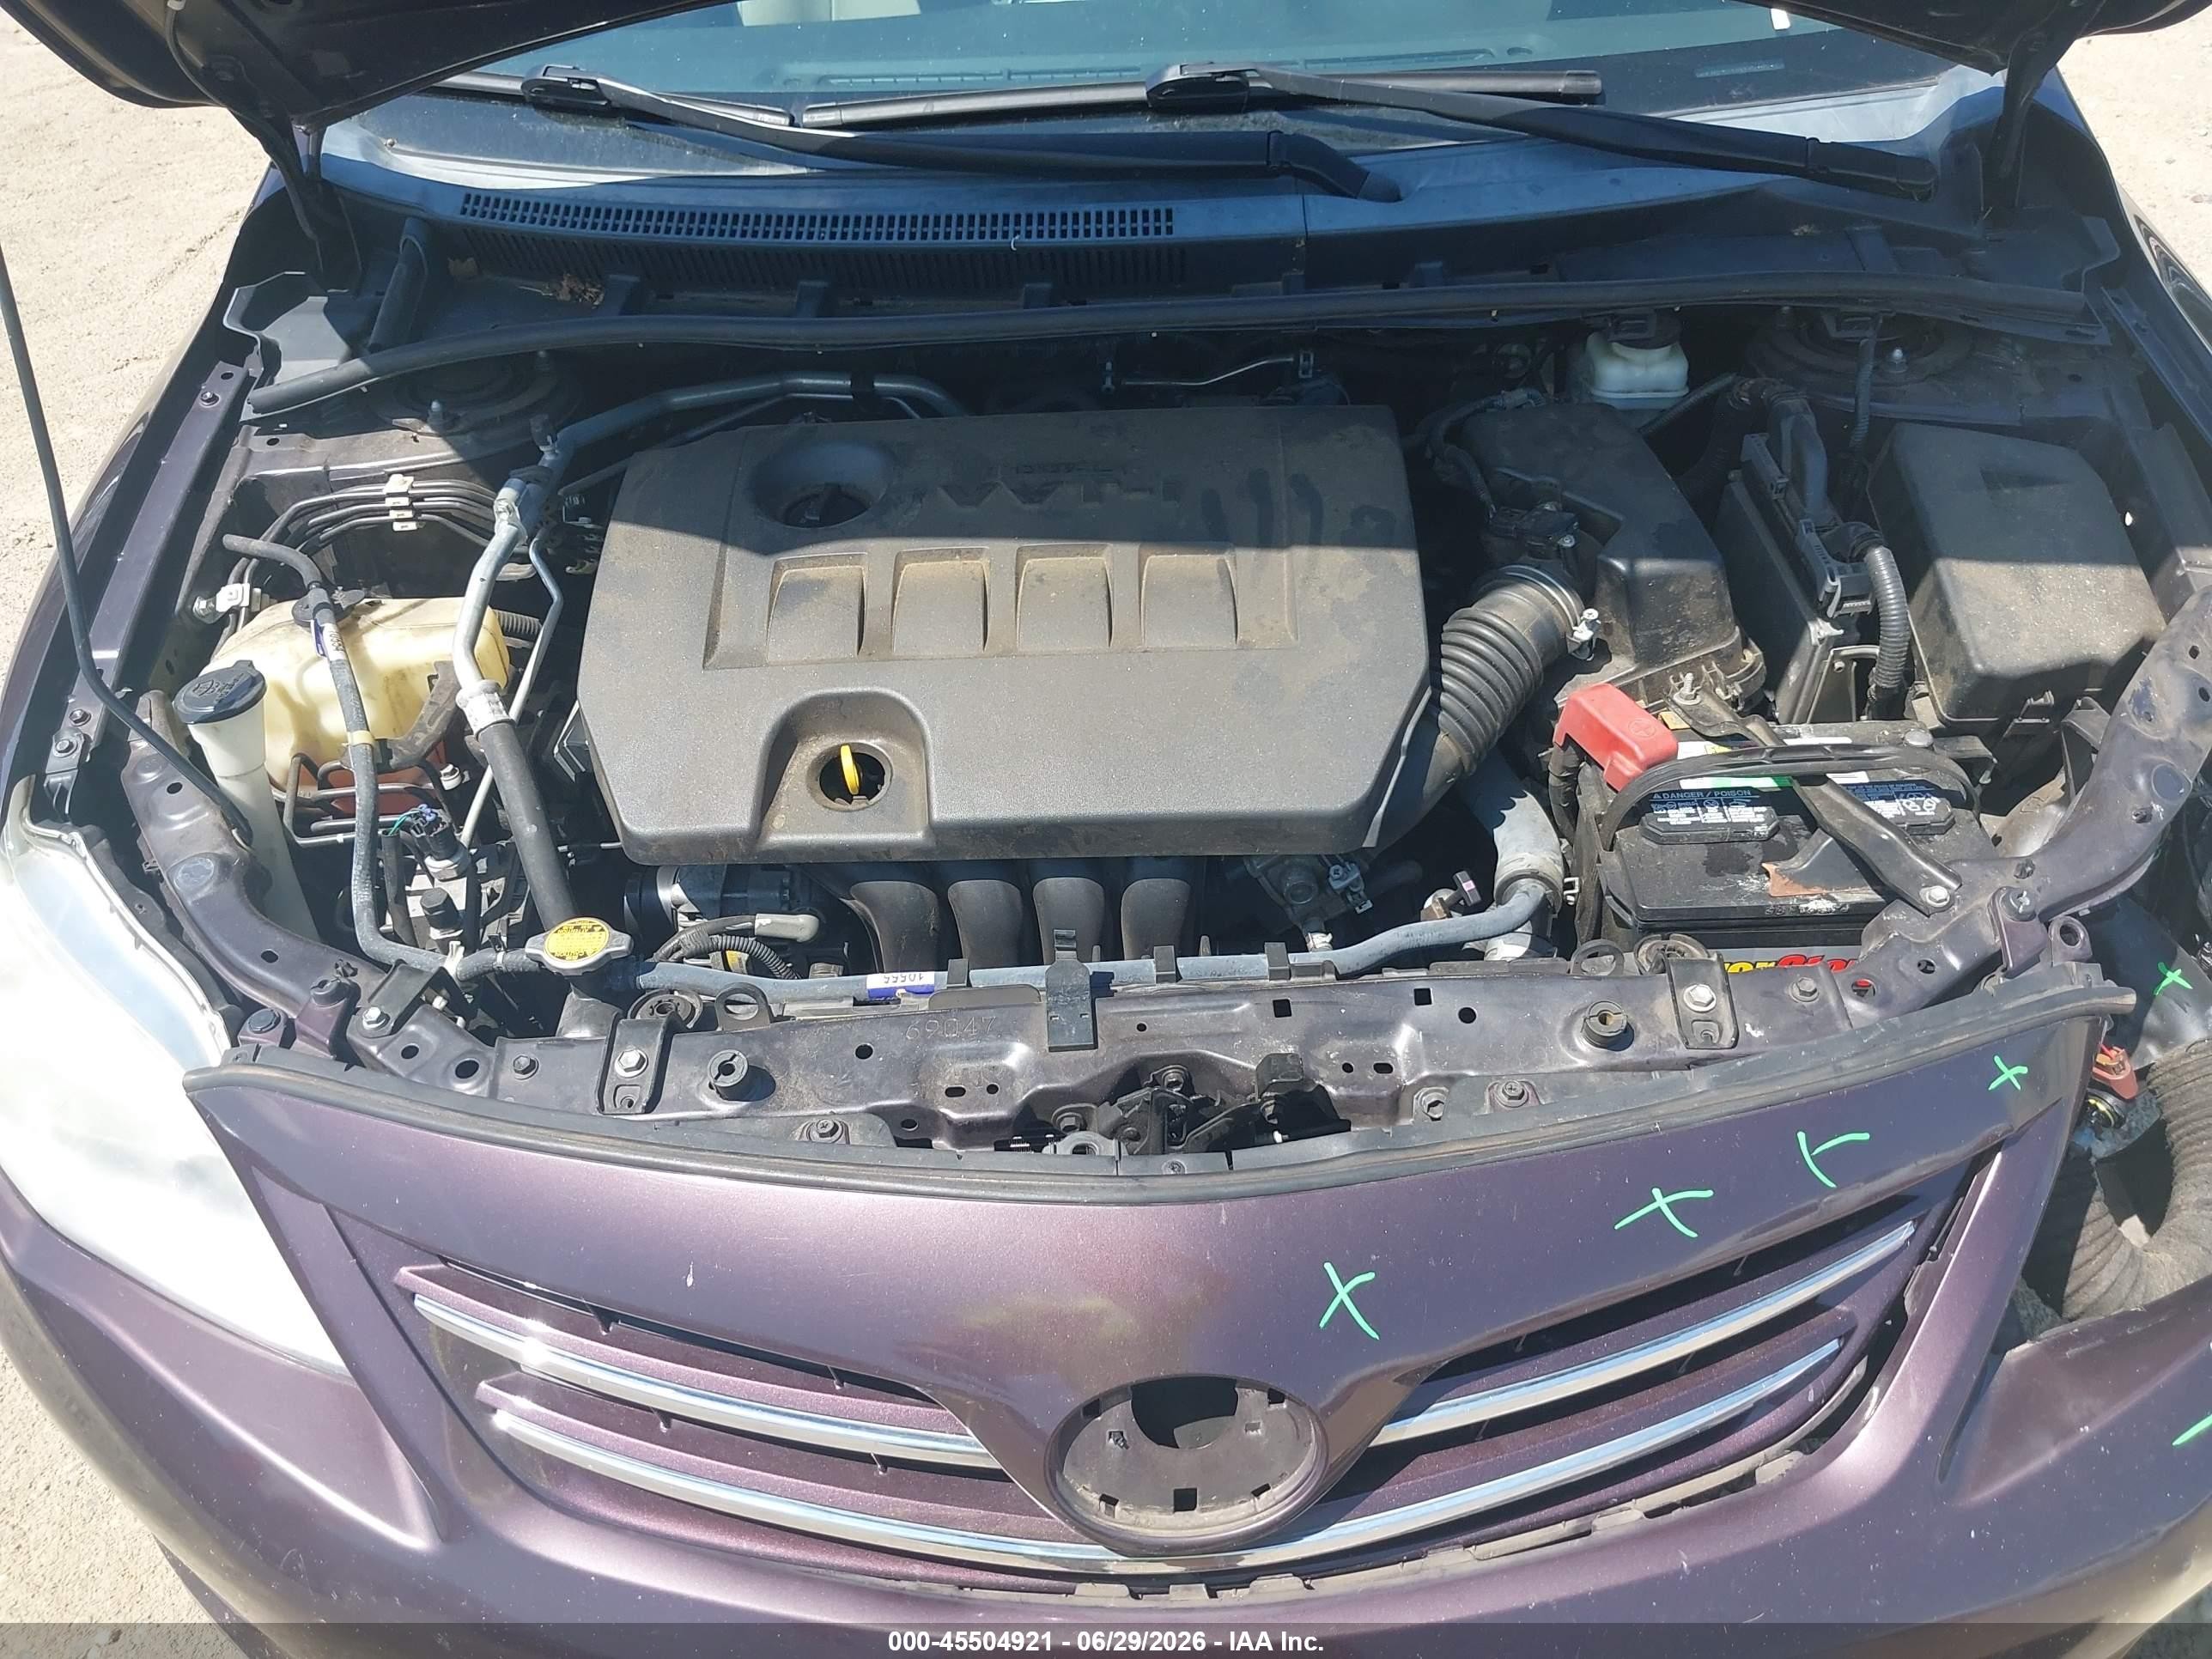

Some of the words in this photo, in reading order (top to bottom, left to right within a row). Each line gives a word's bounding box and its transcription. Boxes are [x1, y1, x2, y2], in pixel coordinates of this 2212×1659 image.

[1662, 791, 1705, 799] DANGER
[1714, 789, 1753, 798] POISON
[906, 1017, 997, 1040] 69047
